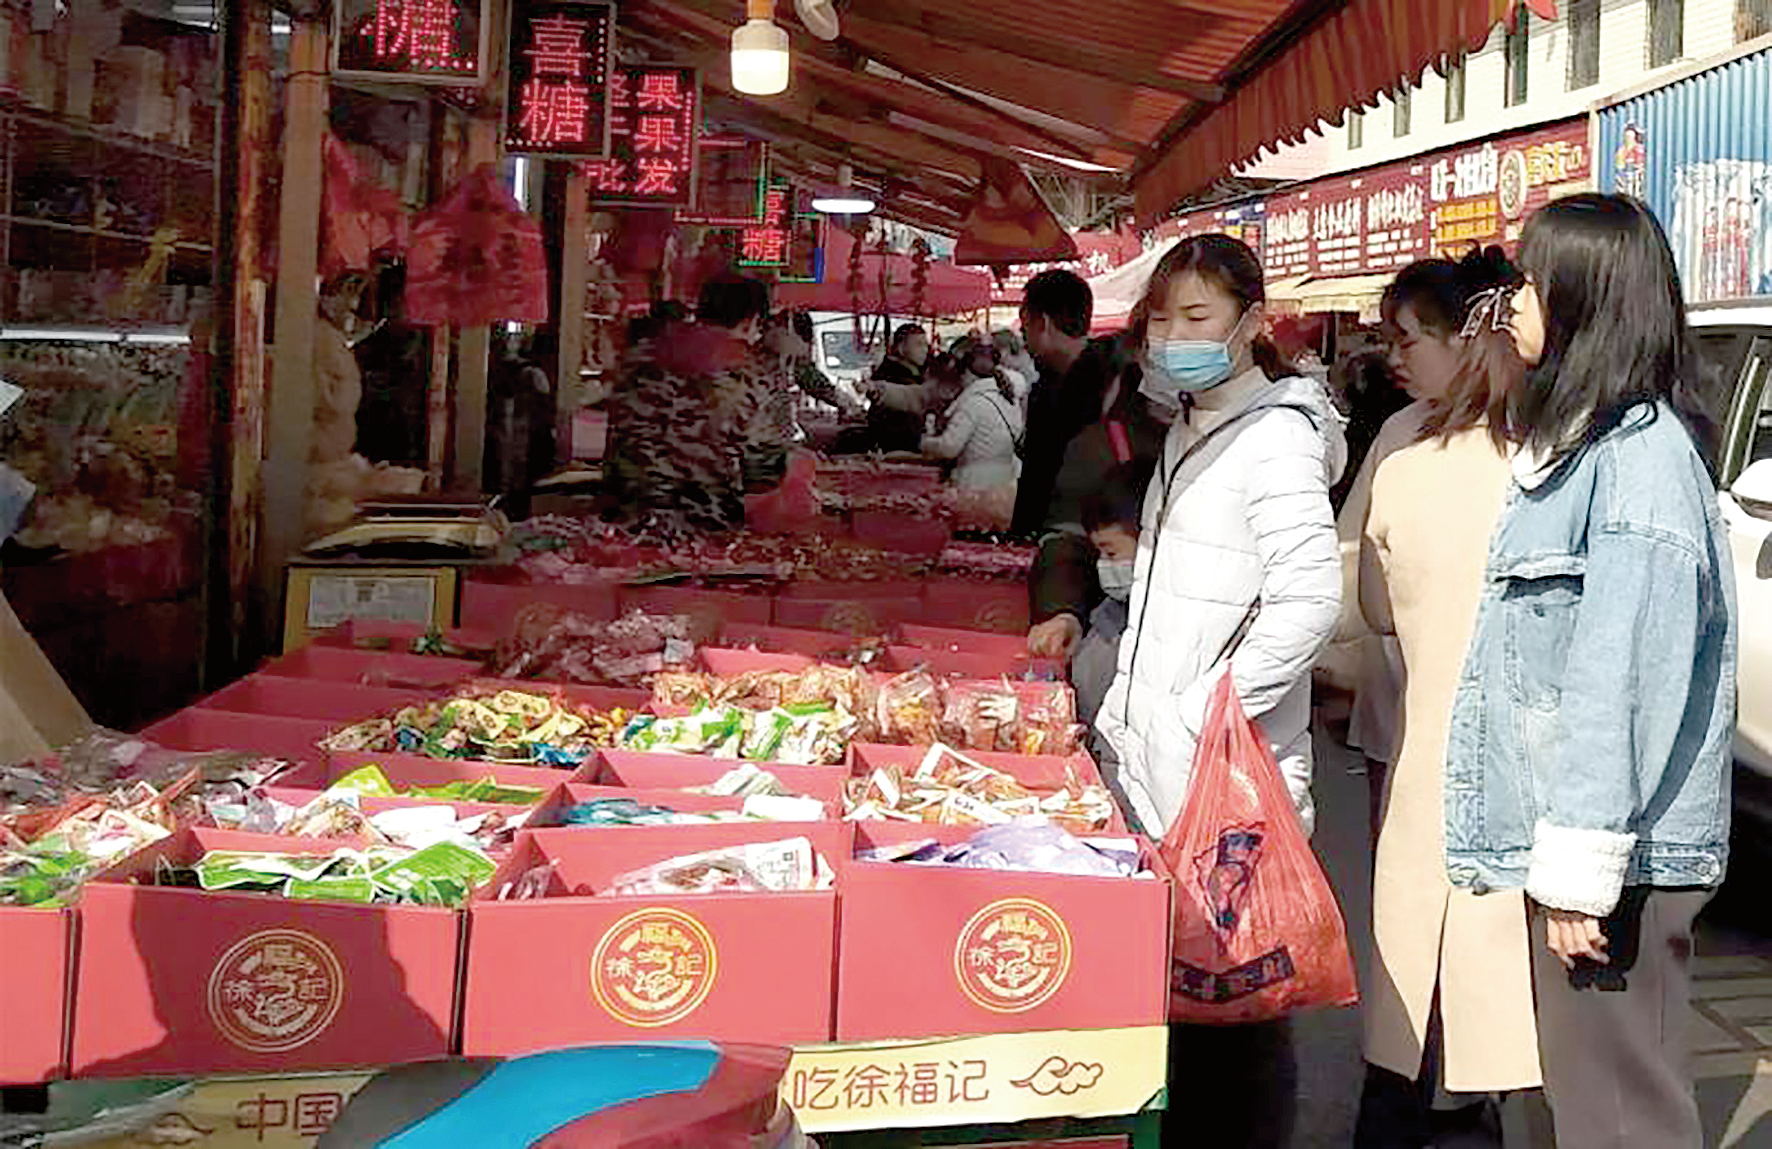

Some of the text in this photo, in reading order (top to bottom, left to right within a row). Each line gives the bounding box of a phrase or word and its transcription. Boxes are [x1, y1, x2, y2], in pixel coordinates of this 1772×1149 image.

[521, 12, 593, 142] 喜糖
[791, 1059, 990, 1111] 吃徐福记
[235, 1092, 343, 1143] 中国
